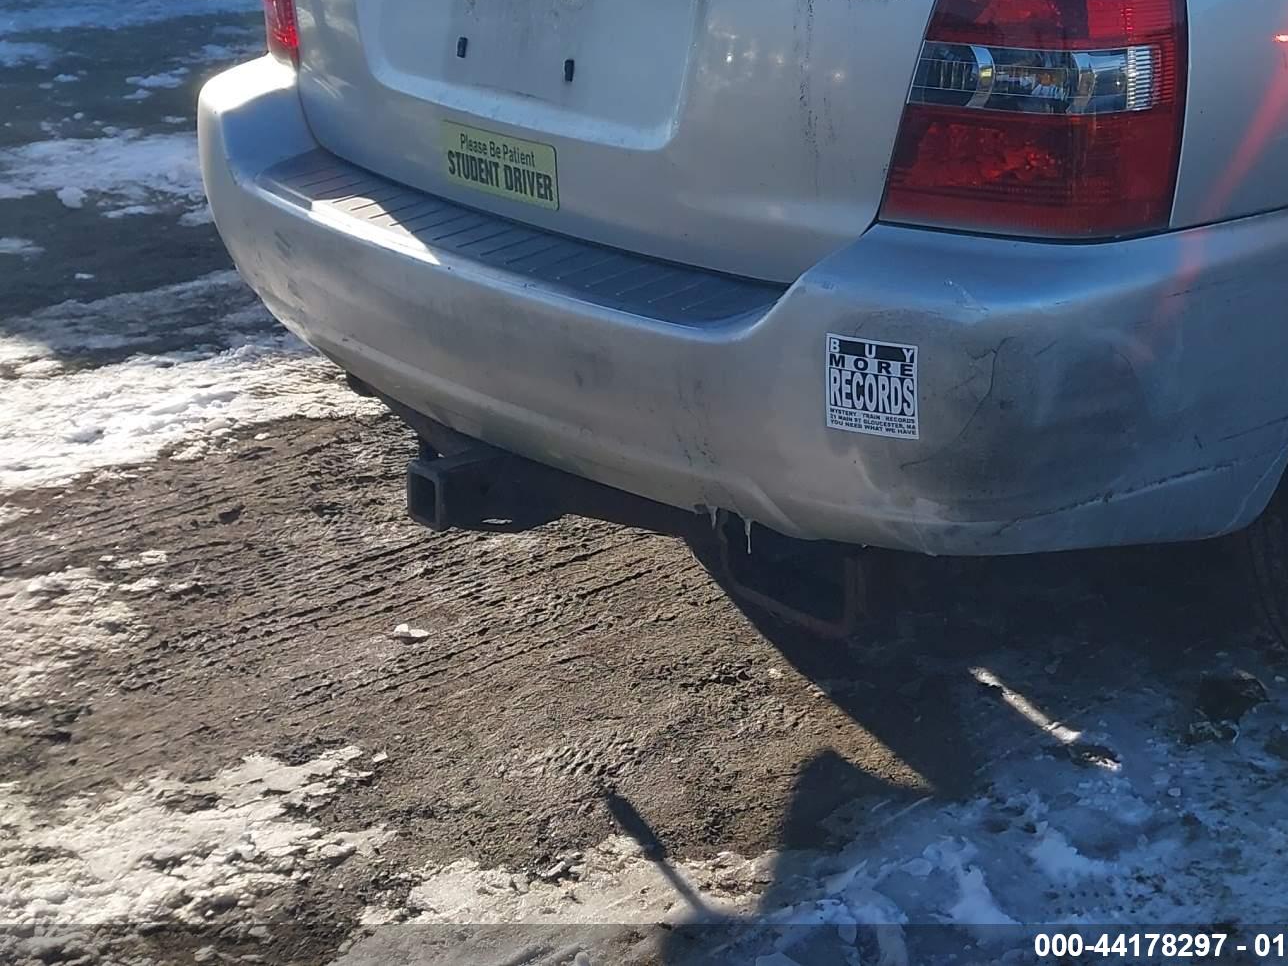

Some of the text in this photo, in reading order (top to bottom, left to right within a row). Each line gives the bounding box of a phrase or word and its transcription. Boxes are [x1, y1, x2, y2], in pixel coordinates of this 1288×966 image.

[460, 133, 535, 167] Please Be Patient
[447, 150, 553, 201] STUDENT DRIVER
[829, 353, 914, 377] MORE
[830, 368, 914, 416] RECORDS
